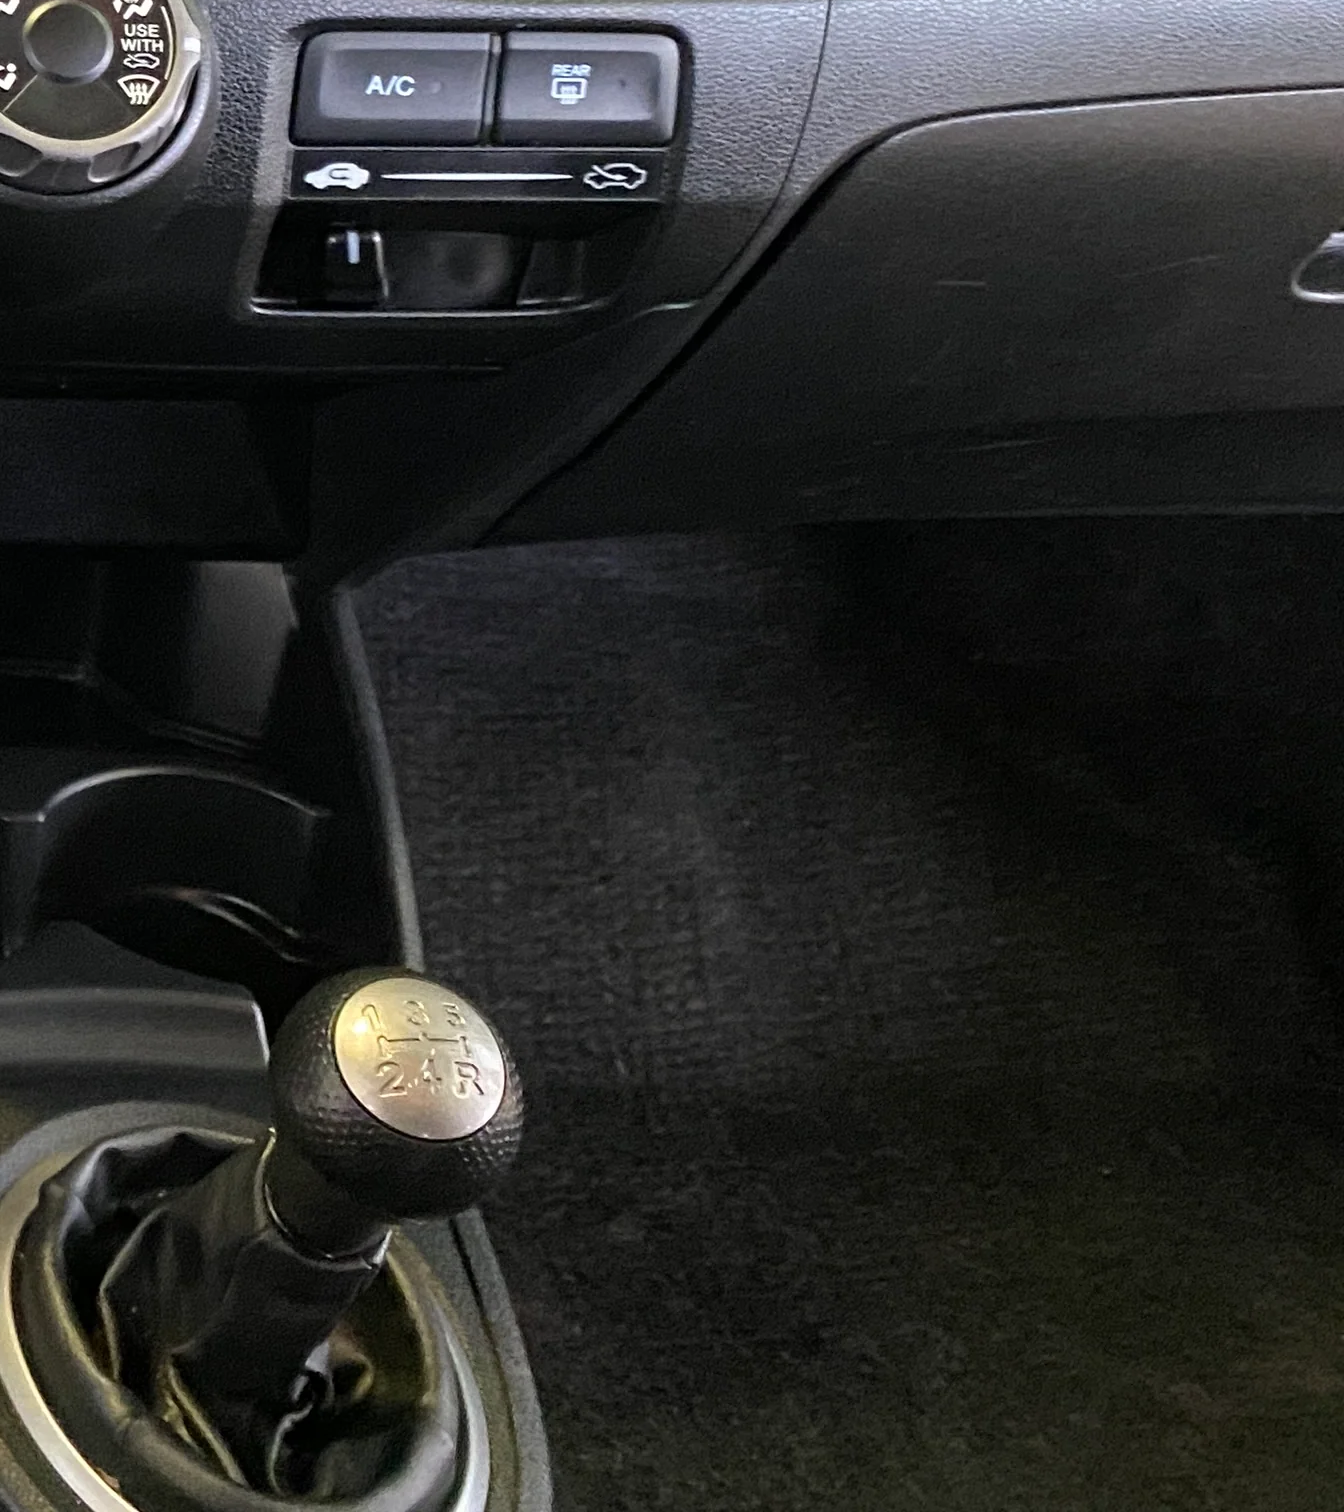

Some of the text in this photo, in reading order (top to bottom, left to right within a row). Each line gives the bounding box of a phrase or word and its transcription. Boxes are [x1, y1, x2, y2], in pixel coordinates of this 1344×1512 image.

[123, 23, 160, 38] USE
[120, 38, 163, 53] WITH
[551, 64, 592, 77] REAR
[365, 74, 416, 97] A/C
[376, 1061, 408, 1098] 2
[453, 1060, 485, 1099] R
